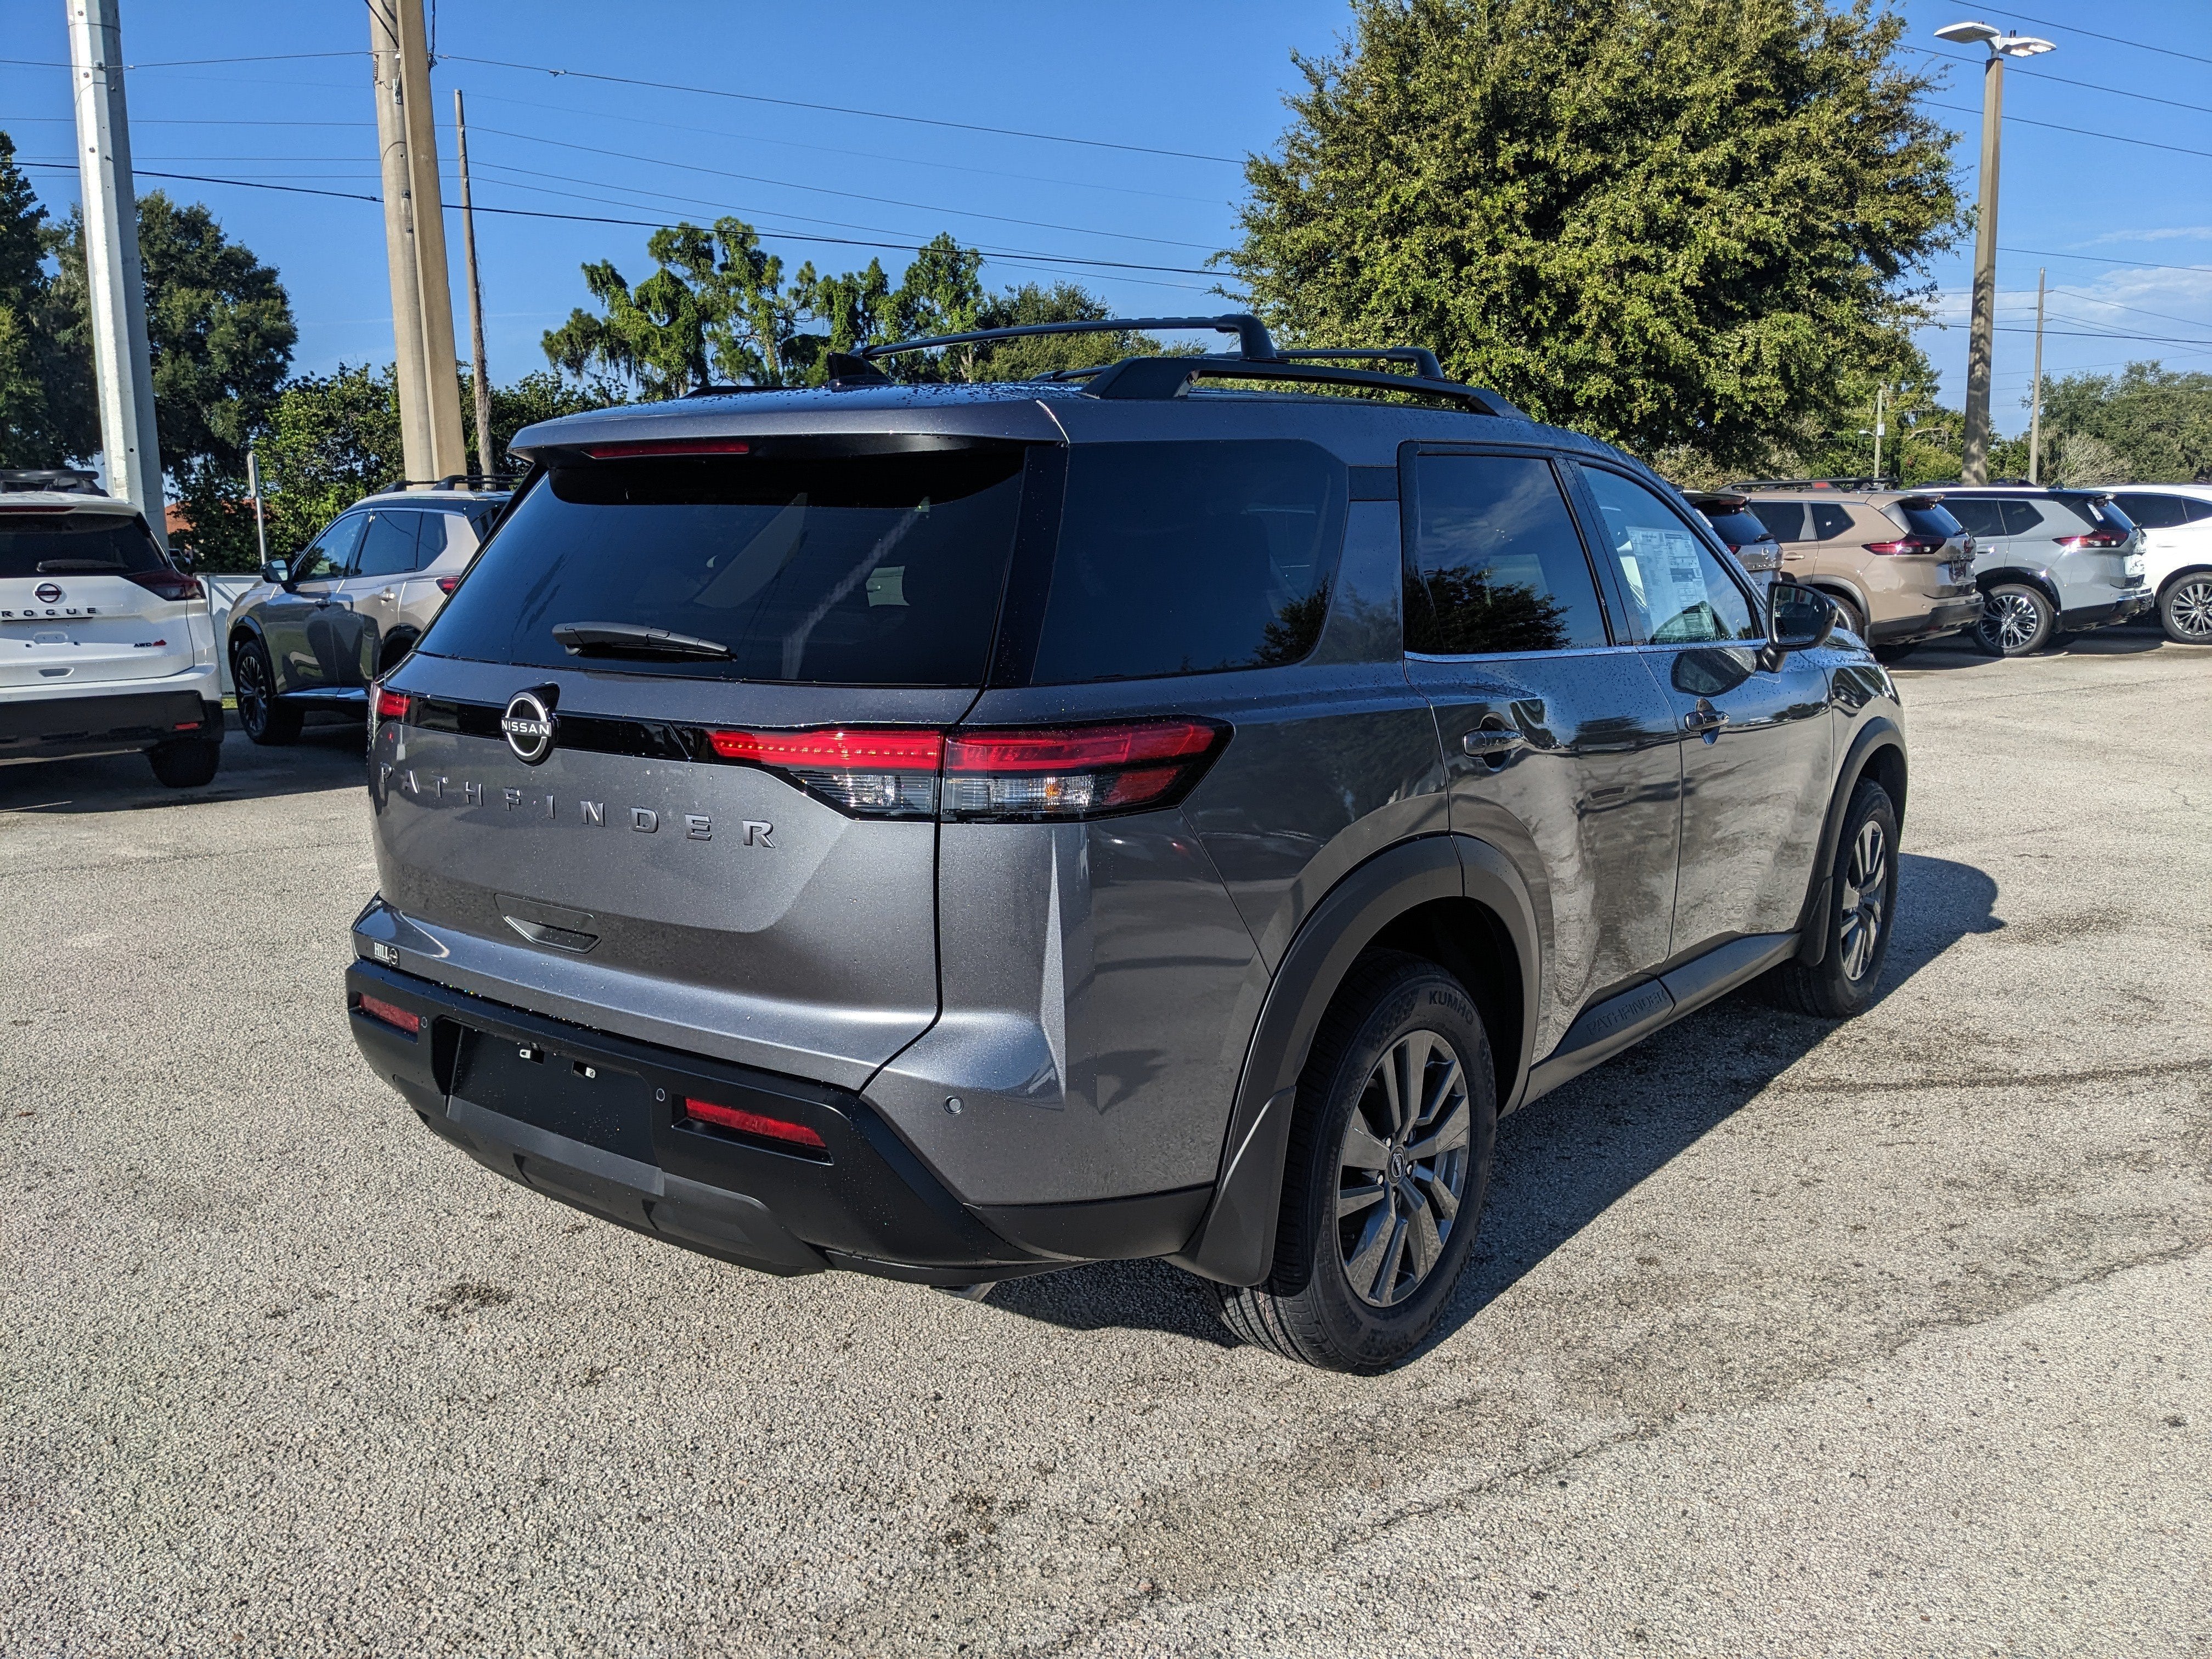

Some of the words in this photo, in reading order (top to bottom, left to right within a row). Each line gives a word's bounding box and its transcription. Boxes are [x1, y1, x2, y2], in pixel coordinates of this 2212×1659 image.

[1, 608, 97, 617] ROGUE
[501, 720, 549, 735] NISSAN
[380, 761, 776, 849] PATHFINDER
[374, 942, 390, 960] HILL
[1429, 991, 1474, 1025] KUMHO
[1585, 989, 1667, 1034] PATHFINDER
